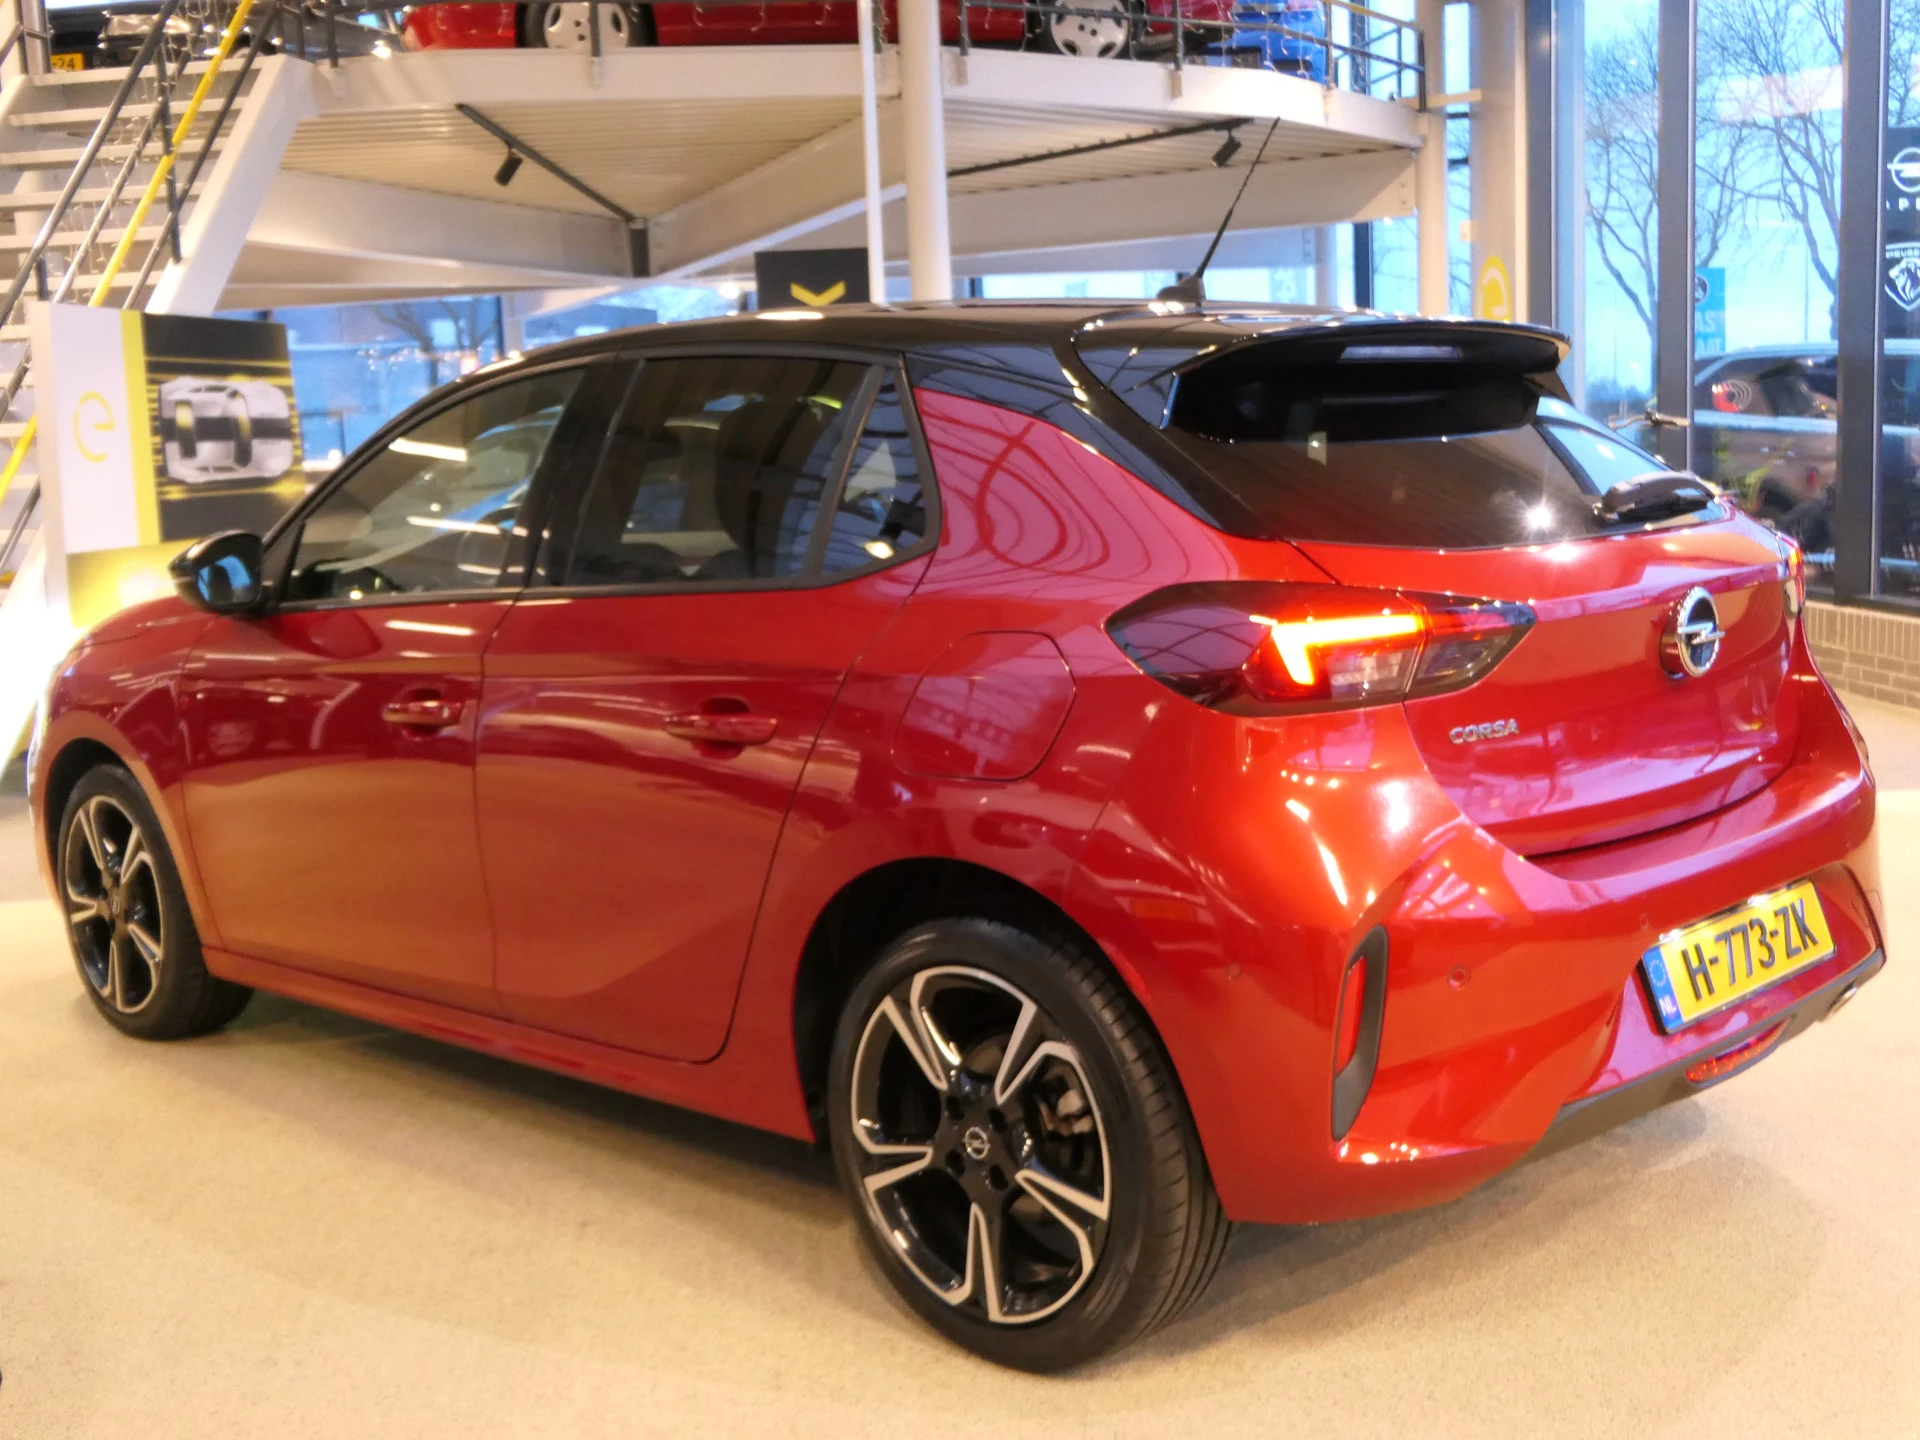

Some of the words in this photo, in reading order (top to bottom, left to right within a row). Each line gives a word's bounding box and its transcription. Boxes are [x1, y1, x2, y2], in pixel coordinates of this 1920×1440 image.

[1449, 718, 1519, 745] CORSA
[1681, 898, 1819, 1001] H-773-ZK
[1658, 995, 1678, 1017] NL
